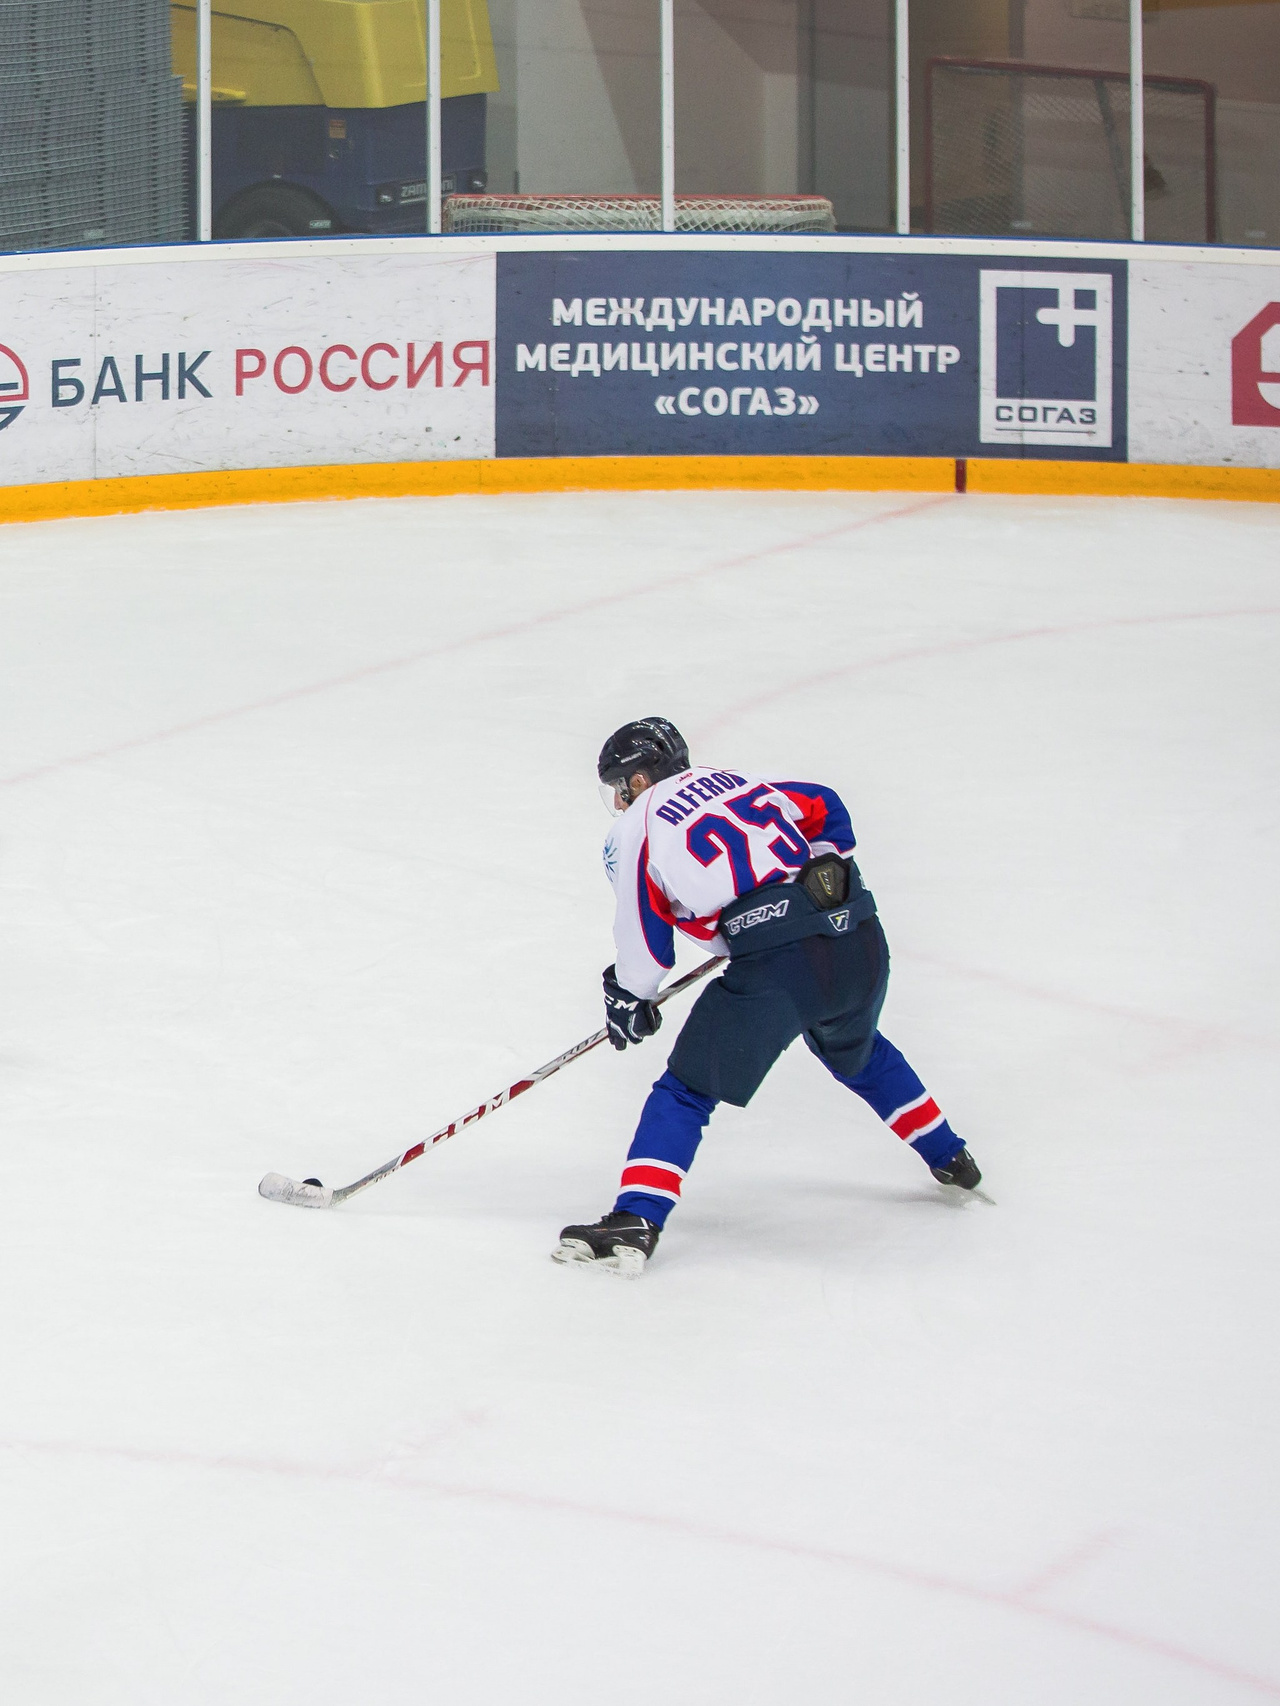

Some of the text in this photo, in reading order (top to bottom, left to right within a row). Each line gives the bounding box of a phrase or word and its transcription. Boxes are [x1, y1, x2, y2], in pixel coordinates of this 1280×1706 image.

[401, 180, 454, 198] ZAMNI
[552, 292, 924, 331] МЕЖДУНАРОДНЫЙ
[51, 340, 490, 408] БАНК РОССИЯ
[516, 335, 961, 378] МЕДИЦИНСКИЙ ЦЕНТР
[654, 387, 820, 416] «СОГАЗ»
[995, 405, 1097, 425] СОГАЗ
[686, 783, 811, 897] 25
[724, 899, 790, 936] CCM
[422, 1085, 512, 1154] CCM
